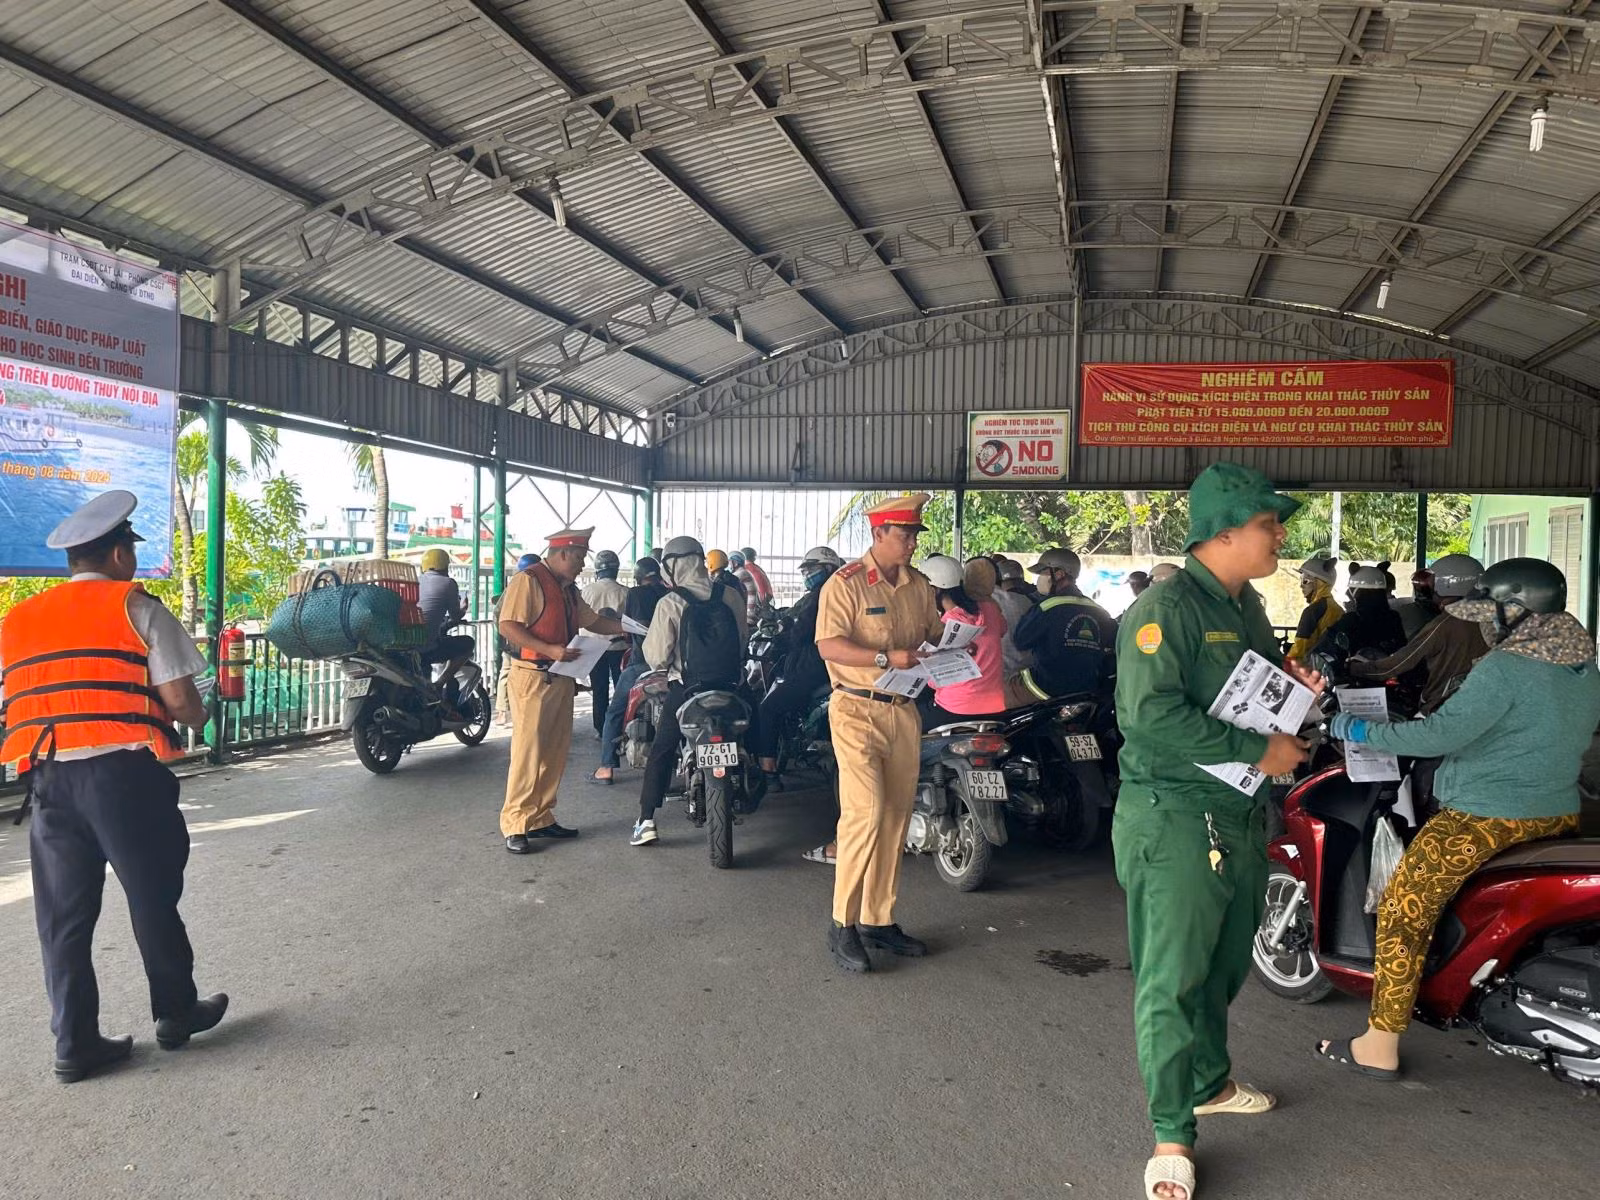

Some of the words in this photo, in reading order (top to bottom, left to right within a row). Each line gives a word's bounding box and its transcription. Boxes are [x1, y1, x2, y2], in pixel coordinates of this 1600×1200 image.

[80, 258, 98, 271] CSGT
[149, 279, 165, 290] CSGT
[0, 308, 32, 332] BIẾN,
[35, 317, 62, 337] GIÁO
[66, 326, 88, 345] DỤC
[91, 331, 119, 350] PHÁP
[122, 338, 147, 358] LUẬT
[20, 341, 44, 361] HỌC
[48, 347, 75, 366] SINH
[79, 350, 100, 371] ĐẾN
[103, 358, 143, 380] TRƯỜNG
[1201, 369, 1275, 387] NGHIÊM
[1280, 366, 1325, 387] CẤM
[19, 366, 49, 386] TRÊN
[52, 372, 90, 394] ĐƯỜNG
[122, 386, 140, 405] NỘI
[142, 392, 159, 408] ĐỊA
[1102, 391, 1133, 402] HÀNH
[1136, 392, 1146, 401] VI
[1149, 390, 1165, 402] SỬ
[1168, 392, 1199, 403] DỤNG
[1202, 391, 1230, 402] KÍCH
[1232, 391, 1260, 403] ĐIỆN
[1264, 391, 1302, 401] TRONG
[1305, 391, 1334, 401] KHAI
[1337, 389, 1367, 400] THÁC
[1370, 387, 1401, 400] THỦY
[1404, 387, 1430, 400] SẢN
[1137, 407, 1165, 419] PHẠT
[1169, 406, 1195, 417] TIỀN
[1289, 404, 1313, 416] ĐẾN
[1088, 422, 1112, 433] TỊCH
[1116, 422, 1136, 432] THU
[1139, 421, 1170, 432] CÔNG
[1173, 422, 1188, 434] CỤ
[1191, 421, 1219, 432] KÍCH
[1221, 421, 1249, 434] ĐIỆN
[1252, 420, 1268, 432] VÀ
[1271, 422, 1297, 432] NGƯ
[1299, 422, 1315, 434] CỤ
[1318, 422, 1346, 432] KHAI
[1349, 420, 1380, 432] THÁC
[1384, 418, 1414, 432] THỦY
[1417, 418, 1443, 432] SẢN
[1094, 435, 1109, 443] Quy
[1018, 440, 1053, 462] NO
[40, 465, 54, 478] 08
[85, 469, 111, 483] 2024
[1012, 465, 1059, 475] SMOKING
[703, 743, 731, 755] 72-G1
[1069, 735, 1094, 748] 59-S2
[700, 753, 737, 766] 909.10
[971, 771, 1000, 785] 60-C2
[970, 785, 1004, 799] 782.27
